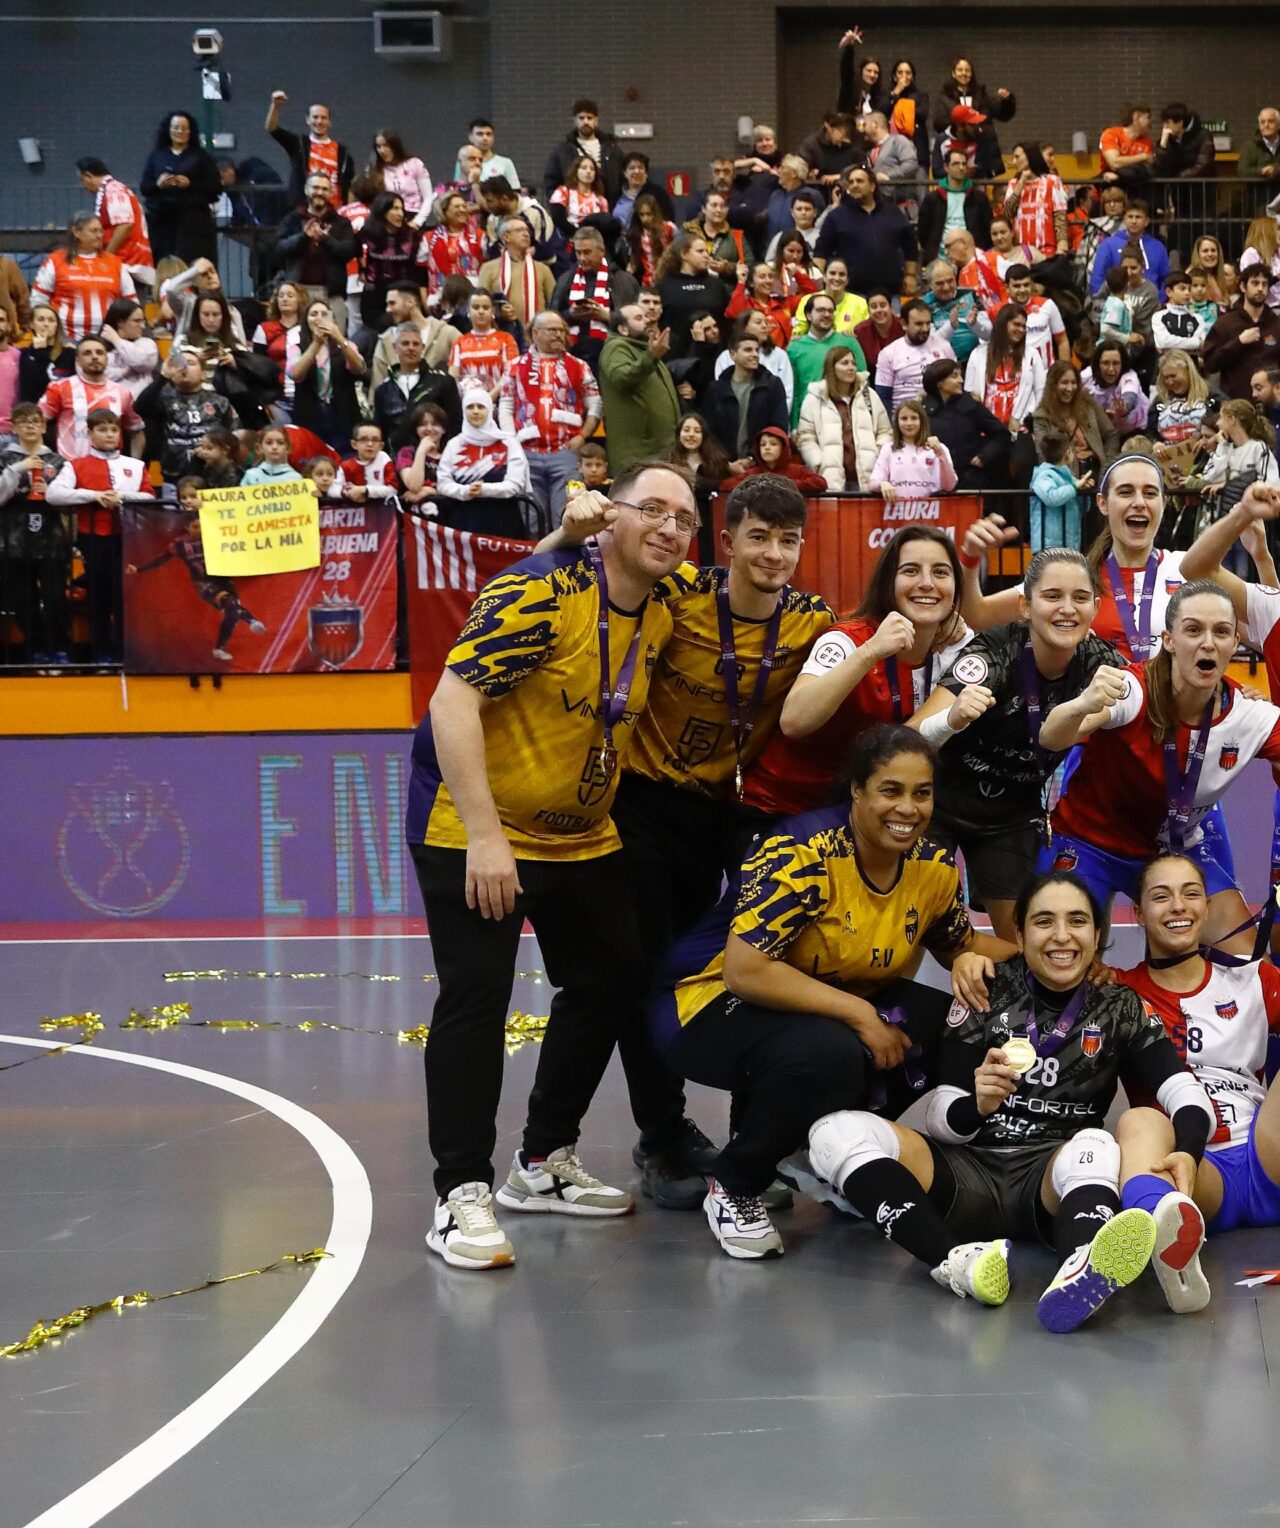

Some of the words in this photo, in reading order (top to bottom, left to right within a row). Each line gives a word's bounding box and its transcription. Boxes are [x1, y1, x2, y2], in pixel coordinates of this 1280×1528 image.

[200, 488, 246, 502] LAURA
[217, 508, 236, 520] TE
[246, 502, 292, 516] CAMBIO
[883, 500, 940, 521] LAURA
[219, 525, 238, 537] TU
[247, 515, 312, 533] CAMISETA
[221, 541, 247, 553] POR
[255, 538, 272, 550] LA
[323, 560, 351, 580] 28
[1172, 1027, 1203, 1054] 58
[1025, 1056, 1060, 1087] 28
[1078, 1151, 1094, 1164] 28
